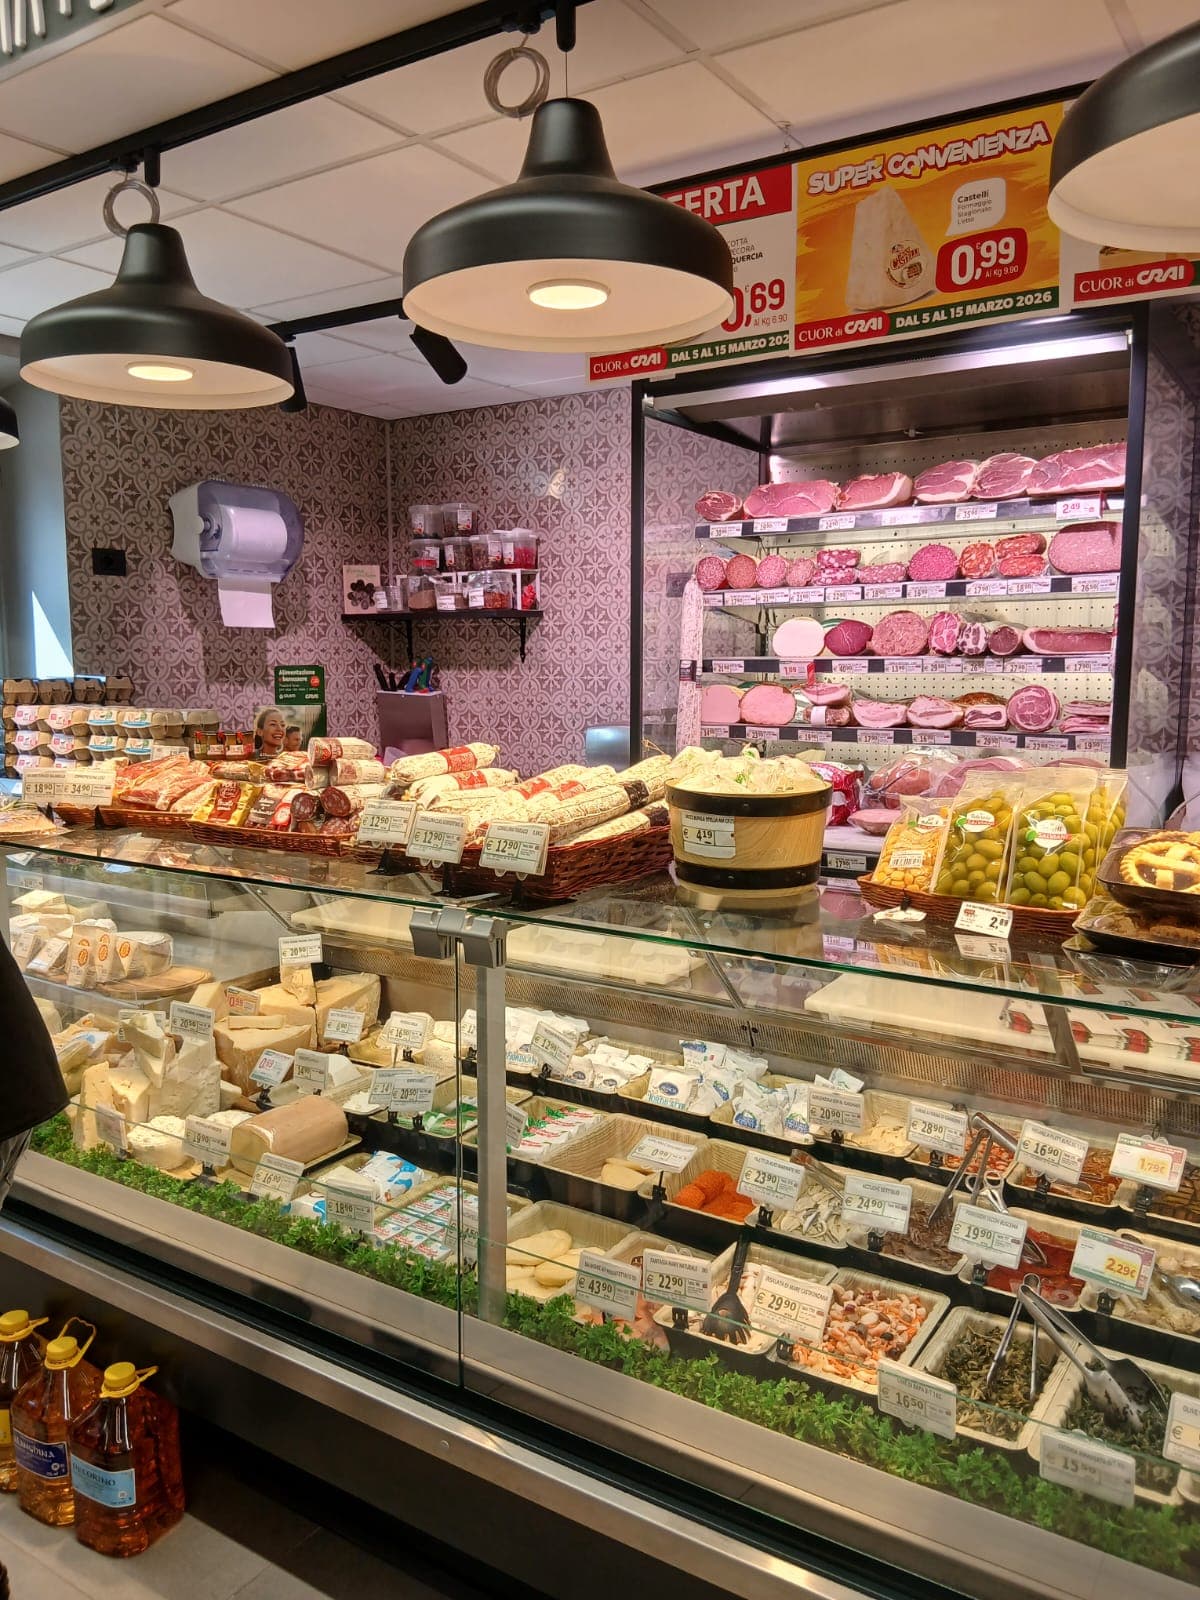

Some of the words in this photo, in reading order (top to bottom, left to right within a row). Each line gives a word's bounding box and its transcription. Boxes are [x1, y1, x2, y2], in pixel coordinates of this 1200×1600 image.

[808, 161, 882, 193] SUPER
[888, 123, 1049, 175] CONVENIENZA
[957, 189, 989, 203] Castelli
[951, 237, 1016, 285] 0,99
[1080, 277, 1123, 293] CUOR
[1125, 278, 1134, 288] di
[1137, 265, 1185, 285] CRAI
[896, 314, 920, 328] DAL
[923, 311, 930, 323] 5
[932, 308, 948, 321] AL
[950, 304, 964, 318] 15
[966, 296, 1014, 316] MARZO
[1016, 291, 1052, 308] 2026
[799, 329, 833, 342] CUOR
[835, 329, 842, 337] di
[844, 317, 882, 334] CRAI
[671, 351, 690, 362] DAL
[692, 350, 699, 360] 5
[700, 347, 713, 358] AL
[715, 344, 727, 356] 15
[729, 338, 766, 353] MARZO
[594, 360, 622, 374] CUOR
[631, 352, 661, 368] CRAI
[34, 783, 53, 793] 1890
[71, 784, 90, 794] 3490
[370, 816, 389, 828] 1290
[422, 831, 443, 844] 1290
[496, 840, 518, 854] 1290
[820, 1107, 840, 1120] 2090
[921, 1120, 943, 1134] 2890
[1033, 1142, 1059, 1157] 1690
[263, 1171, 281, 1185] 1690
[755, 1170, 777, 1184] 2390
[858, 1197, 883, 1209] 2490
[966, 1226, 992, 1240] 1990
[588, 1279, 613, 1294] 4390
[659, 1274, 683, 1290] 2290
[768, 1293, 797, 1312] 2990
[1172, 1425, 1184, 1440] €
